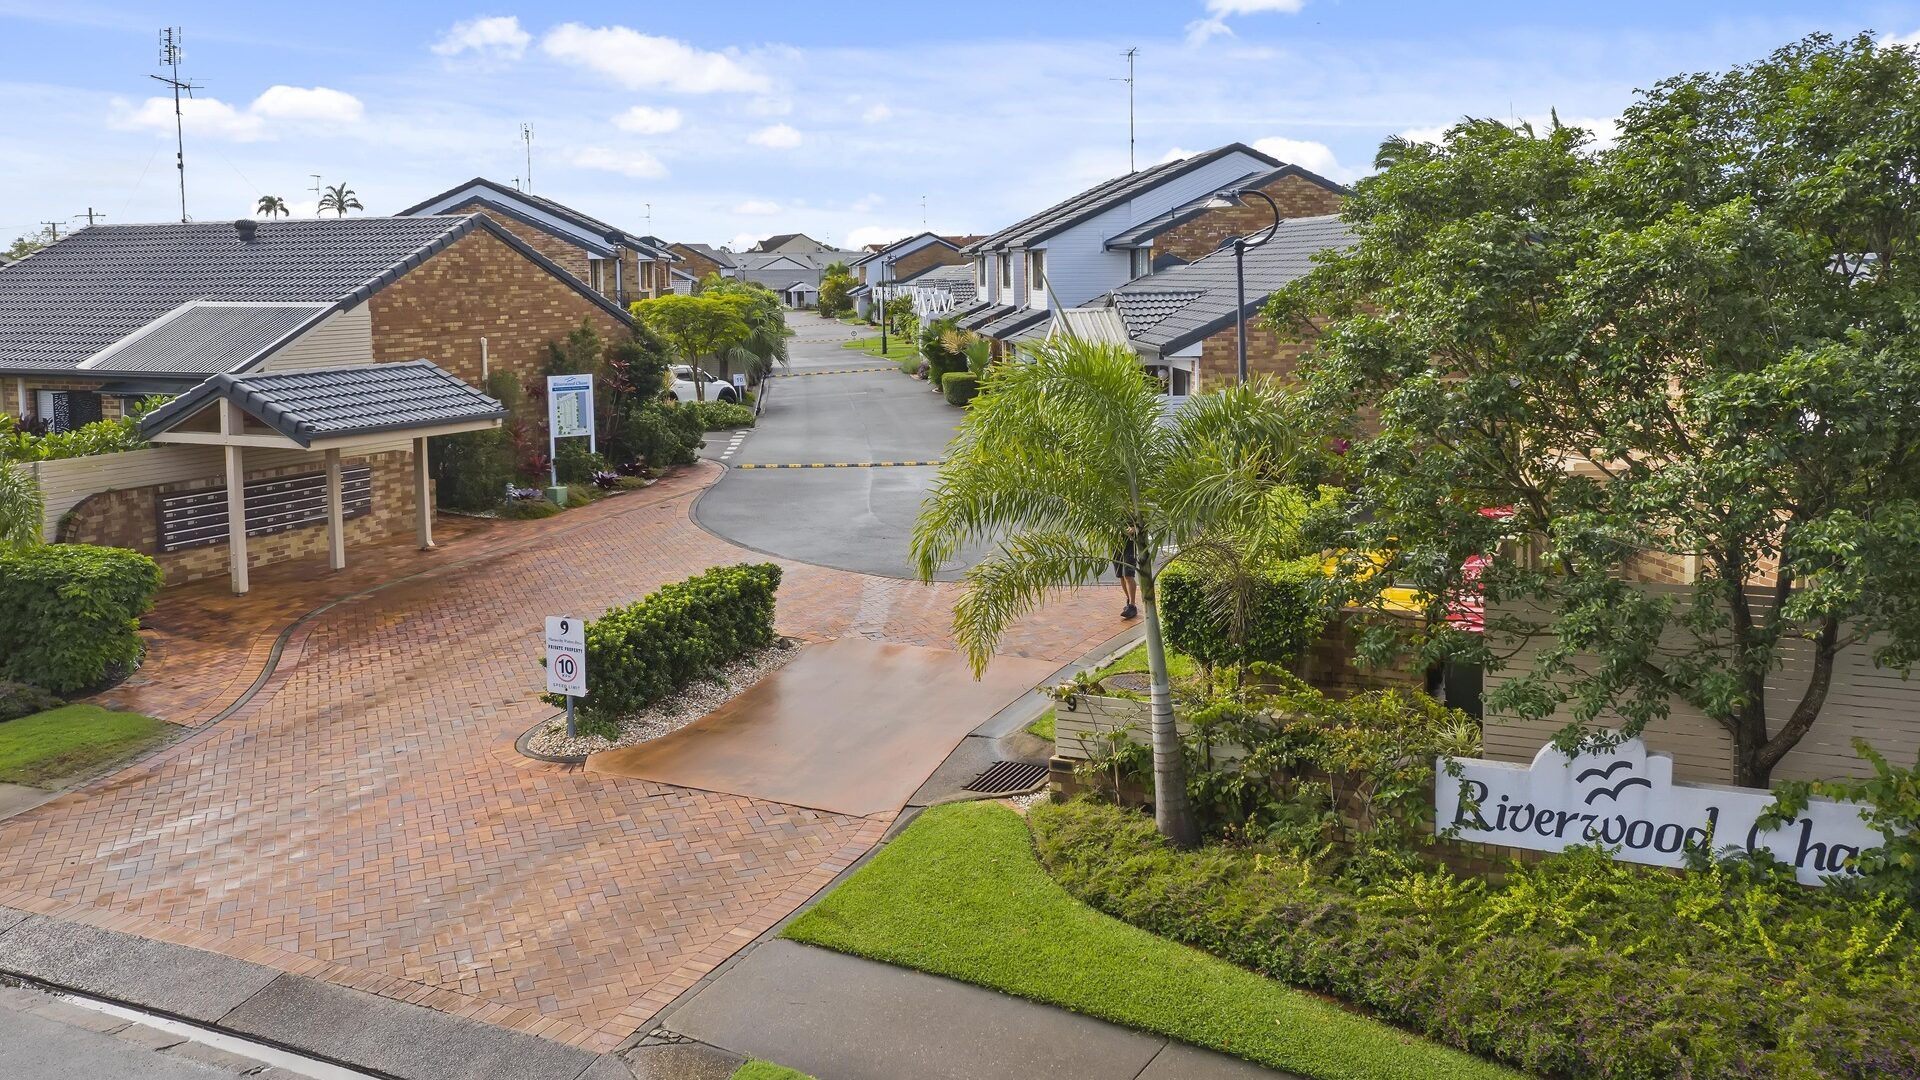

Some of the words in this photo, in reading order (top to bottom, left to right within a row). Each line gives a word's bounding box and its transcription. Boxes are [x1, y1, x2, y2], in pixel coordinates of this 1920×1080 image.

[560, 620, 569, 636] 9
[558, 658, 574, 675] 10
[1452, 777, 1720, 857] Riverwood
[1746, 812, 1868, 877] Cha
